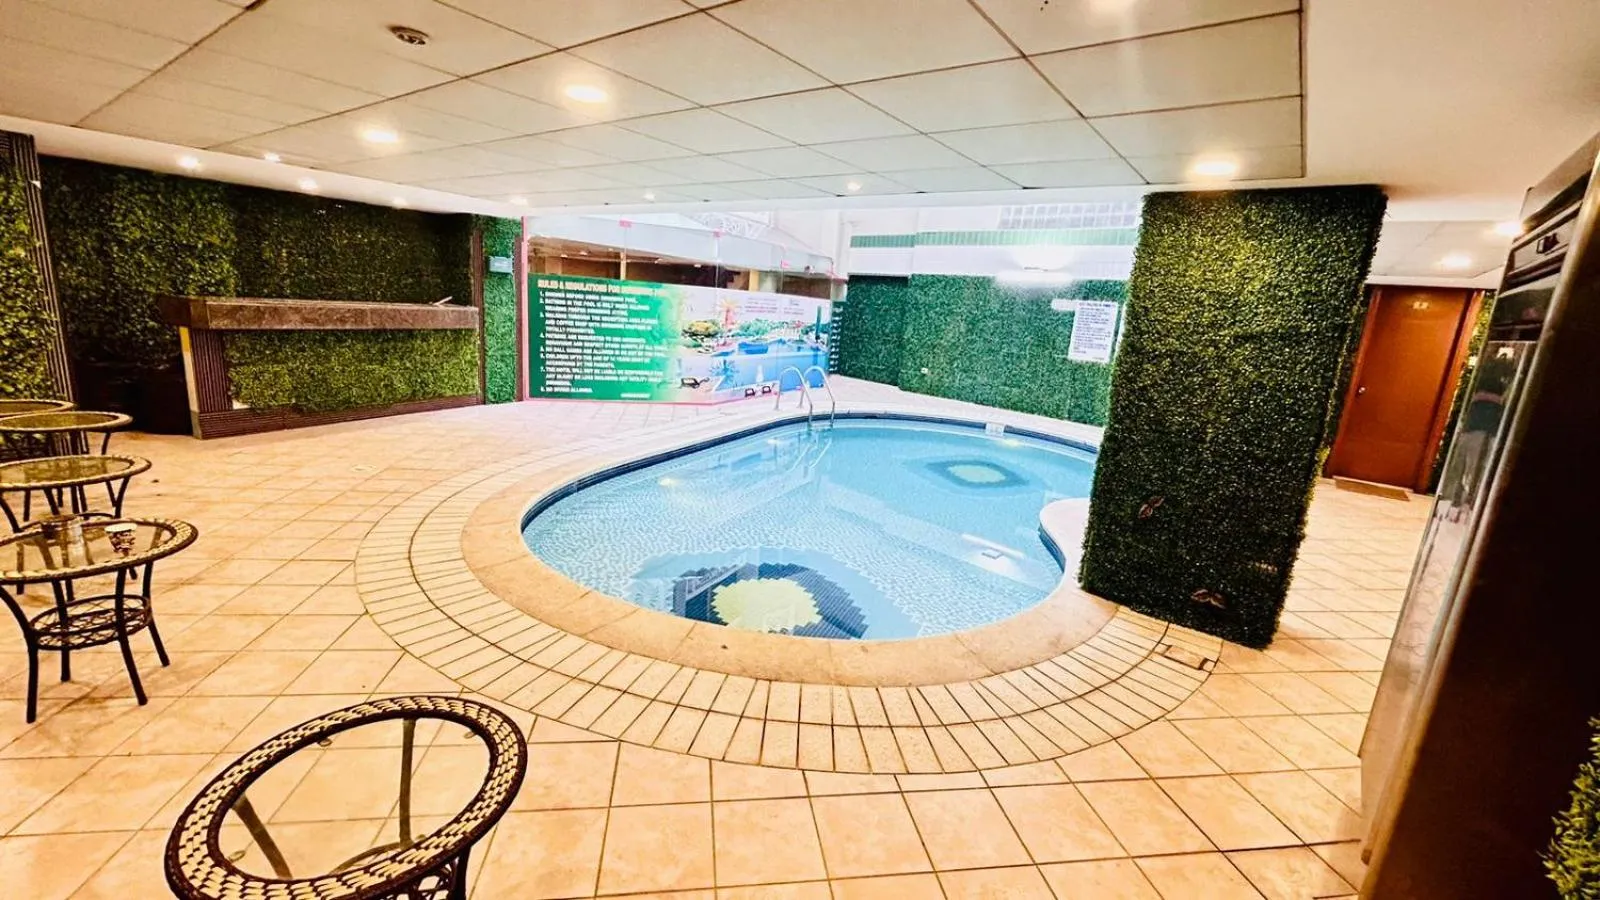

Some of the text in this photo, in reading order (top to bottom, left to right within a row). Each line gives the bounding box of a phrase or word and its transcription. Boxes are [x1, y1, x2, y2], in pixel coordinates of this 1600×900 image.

[538, 280, 558, 289] RULES
[565, 282, 608, 292] REGULATIONS
[608, 285, 620, 294] FOR
